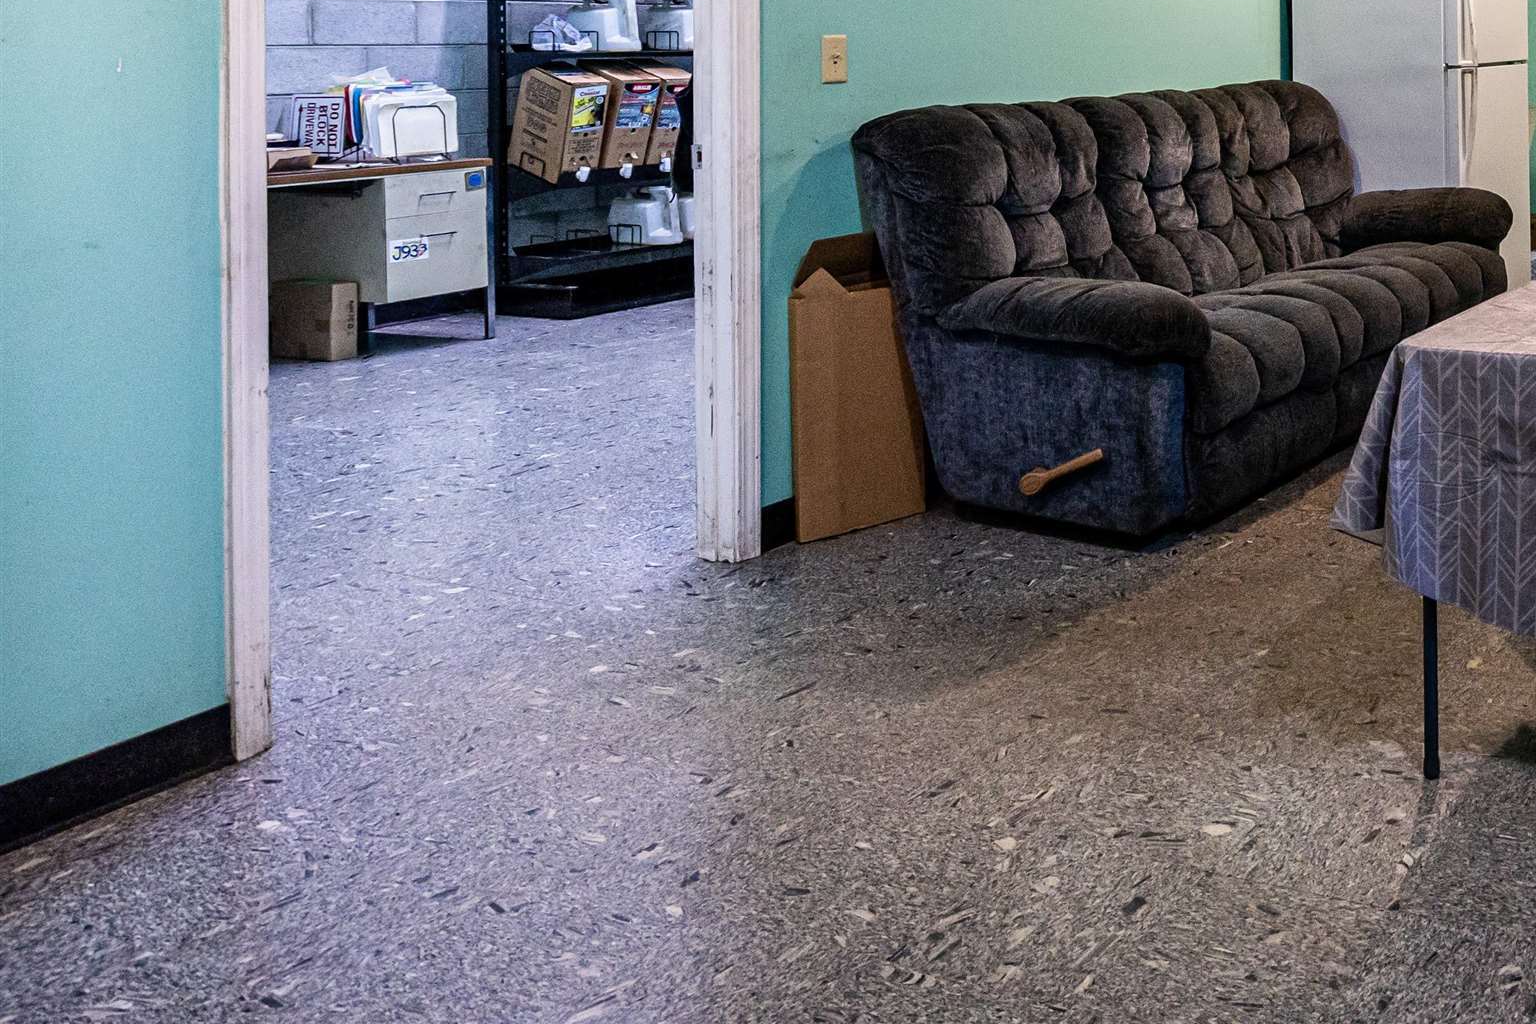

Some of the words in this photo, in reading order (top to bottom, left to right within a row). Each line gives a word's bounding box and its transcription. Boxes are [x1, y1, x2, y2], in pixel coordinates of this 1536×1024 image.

[304, 103, 316, 149] DRIVEWAY
[316, 105, 328, 146] BLOCK
[330, 103, 340, 120] DO
[328, 124, 339, 148] NOT
